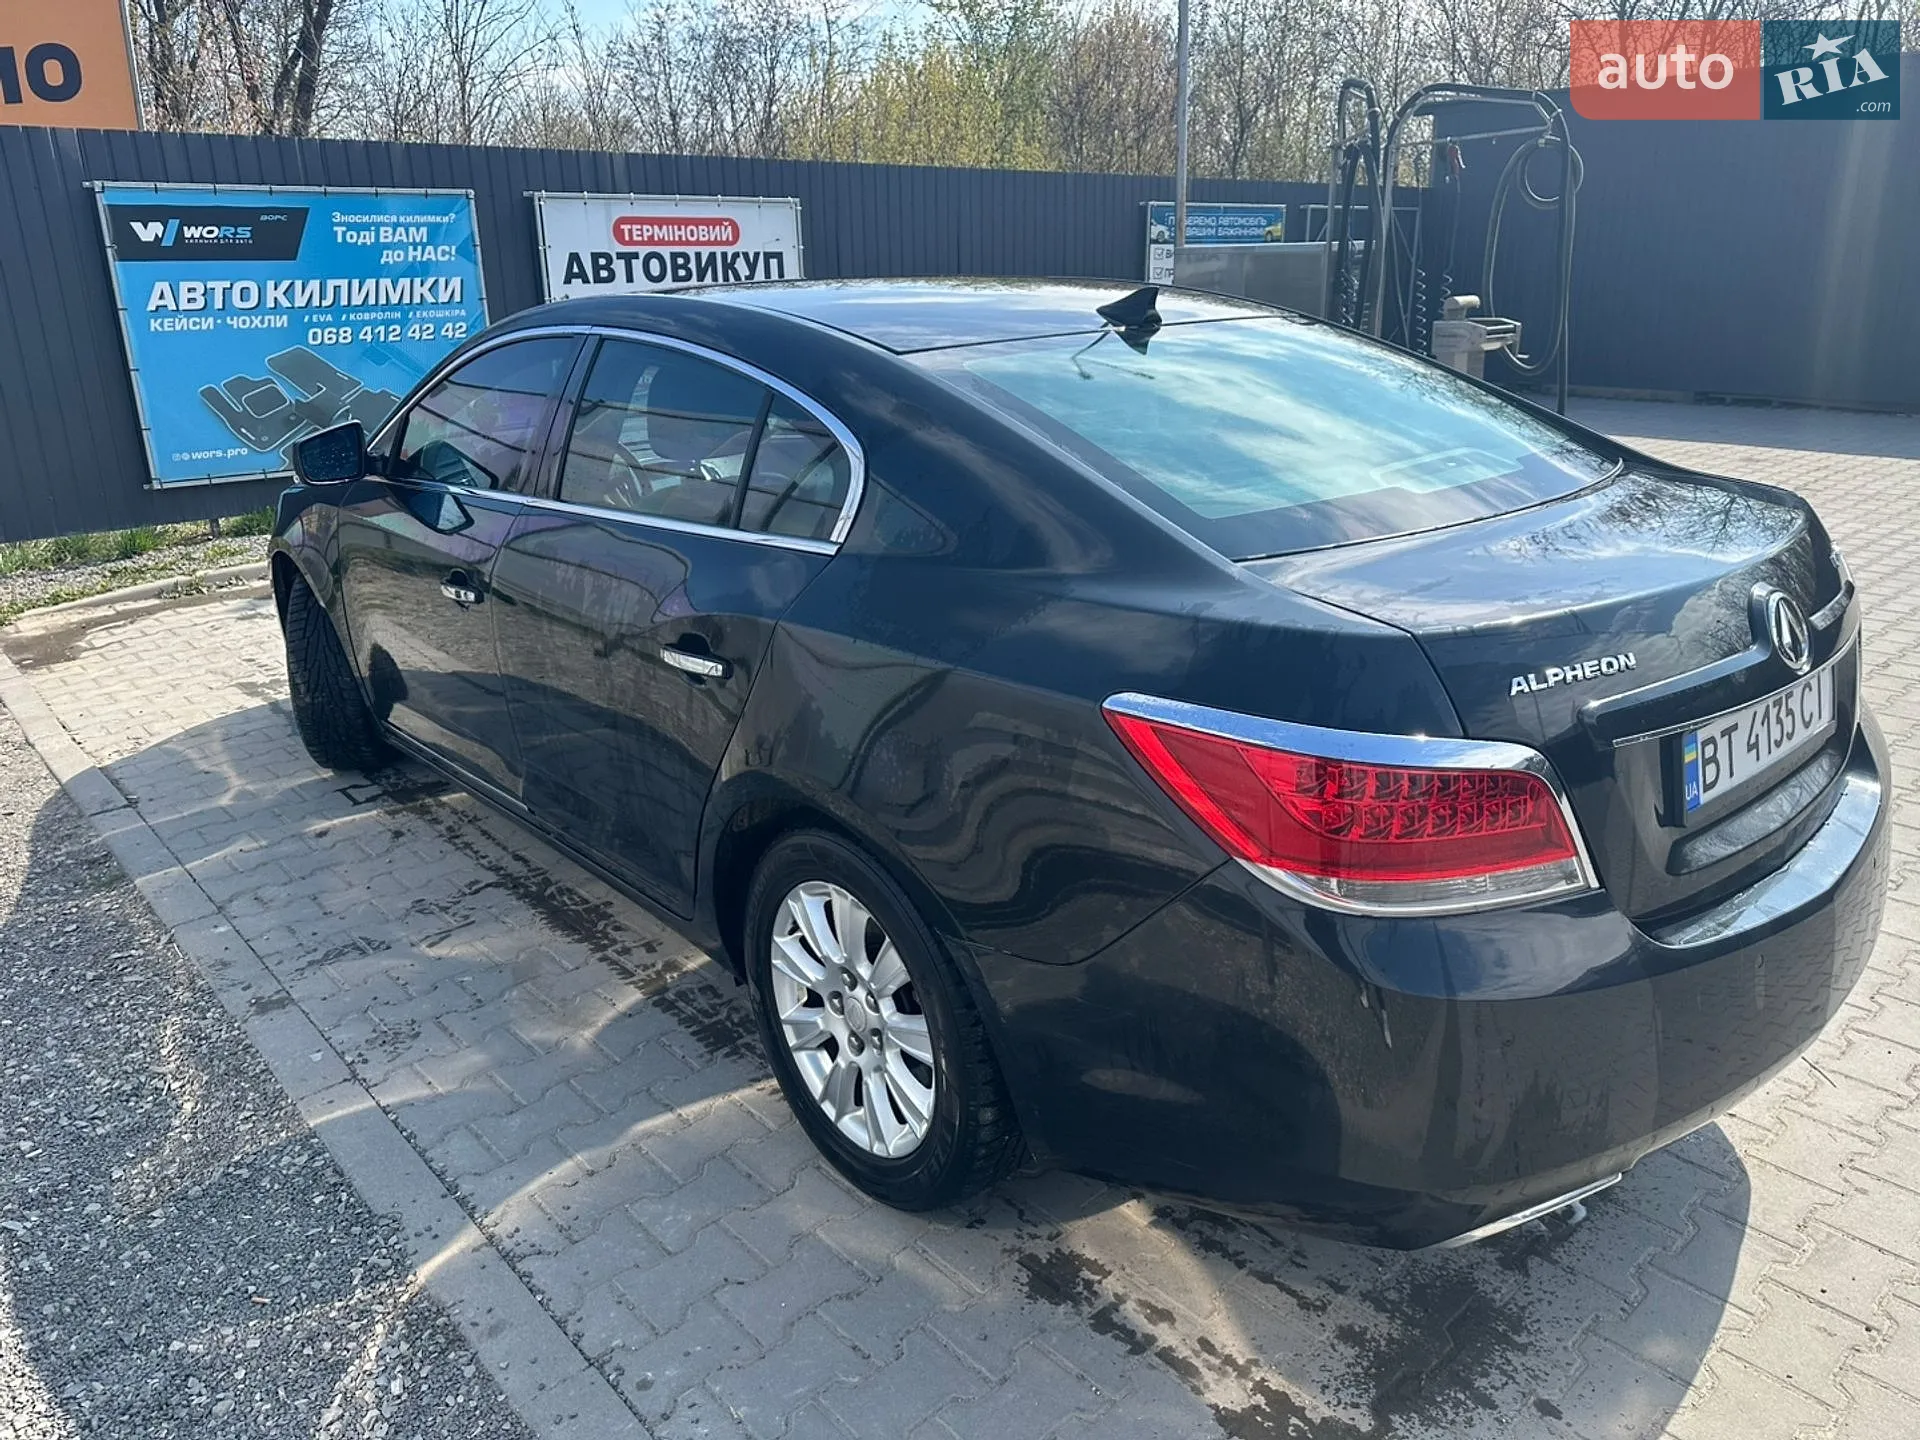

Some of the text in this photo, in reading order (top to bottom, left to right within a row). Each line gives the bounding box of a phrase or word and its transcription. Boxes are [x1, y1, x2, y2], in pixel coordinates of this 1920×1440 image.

[331, 212, 456, 223] Зносилися килимки?
[183, 225, 253, 239] WORS
[333, 226, 428, 245] Тоді ВАМ
[619, 221, 733, 242] ТЕРМІНОВИЙ
[380, 245, 457, 264] до НАС!
[562, 250, 785, 285] АВТОВИКУП
[226, 315, 288, 329] ЧОХЛИ
[349, 311, 402, 321] КОВРОЛІН
[307, 322, 469, 346] 068 412 42 42
[191, 447, 248, 459] wors.pro
[1509, 652, 1637, 697] ALPHEON
[1700, 671, 1823, 794] BT 4135 CI
[1685, 785, 1699, 801] UA
